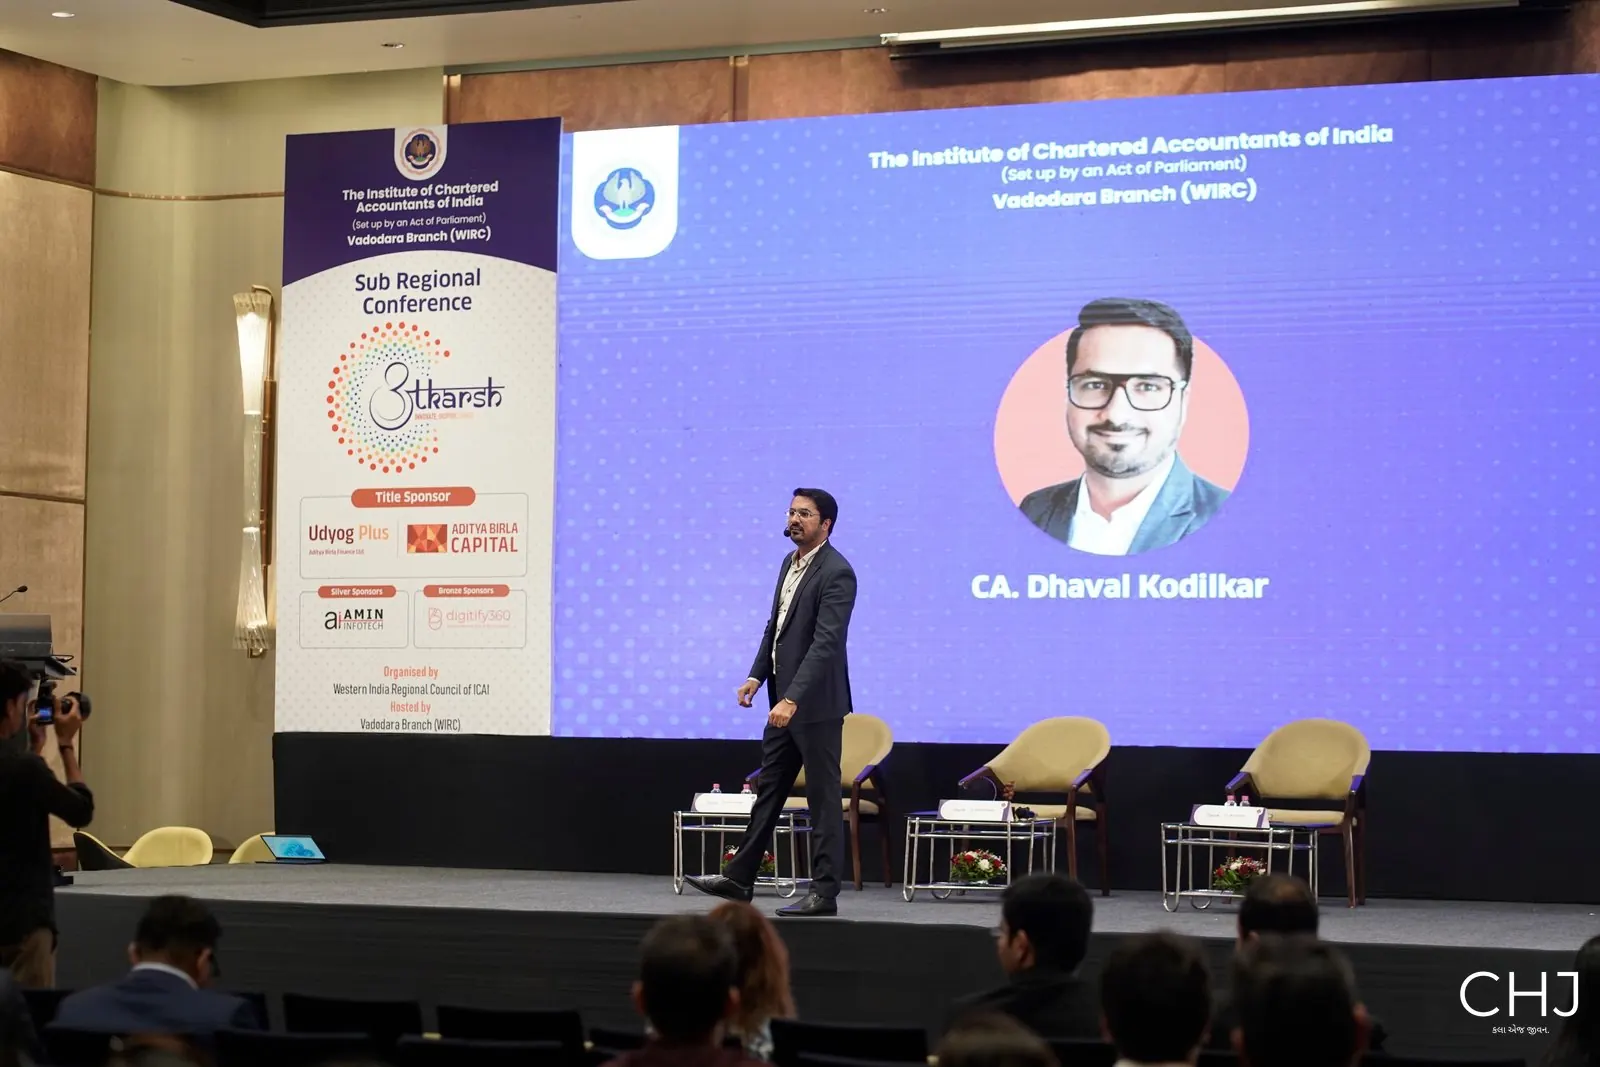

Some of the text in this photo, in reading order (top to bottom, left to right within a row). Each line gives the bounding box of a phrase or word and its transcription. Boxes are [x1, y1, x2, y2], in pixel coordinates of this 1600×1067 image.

[869, 124, 1393, 168] The Institute of Chartered Accountants of India
[1001, 154, 1247, 184] (Set up by an Act of Parliament)
[343, 181, 498, 200] The Institute of Chartered
[992, 178, 1257, 210] Vadodara Branch (WIRC)
[356, 195, 483, 213] Accountants of India
[352, 213, 486, 231] (Set up by an Act of Parliament)
[347, 226, 491, 246] Vadodara Branch (WIRC)
[355, 268, 480, 292] Sub Regional
[363, 295, 472, 314] Conference
[376, 491, 451, 504] Title Sponsor
[309, 524, 389, 544] Udyog Plus
[452, 523, 518, 534] ADITYA BIRLA
[452, 537, 518, 553] CAPITAL
[331, 588, 383, 597] Silver Sponsors
[438, 587, 494, 596] Bronze Sponsors
[971, 572, 1269, 599] CA. Dhaval Kodilkar
[344, 609, 383, 620] AMIN
[447, 609, 510, 623] digitify360
[344, 621, 383, 631] INFOTECH
[384, 666, 438, 679] Organised by
[333, 683, 489, 697] Western India Regional Council of ICAI
[390, 701, 431, 715] Hosted by
[360, 719, 460, 732] Vadodara Branch (WIRC)
